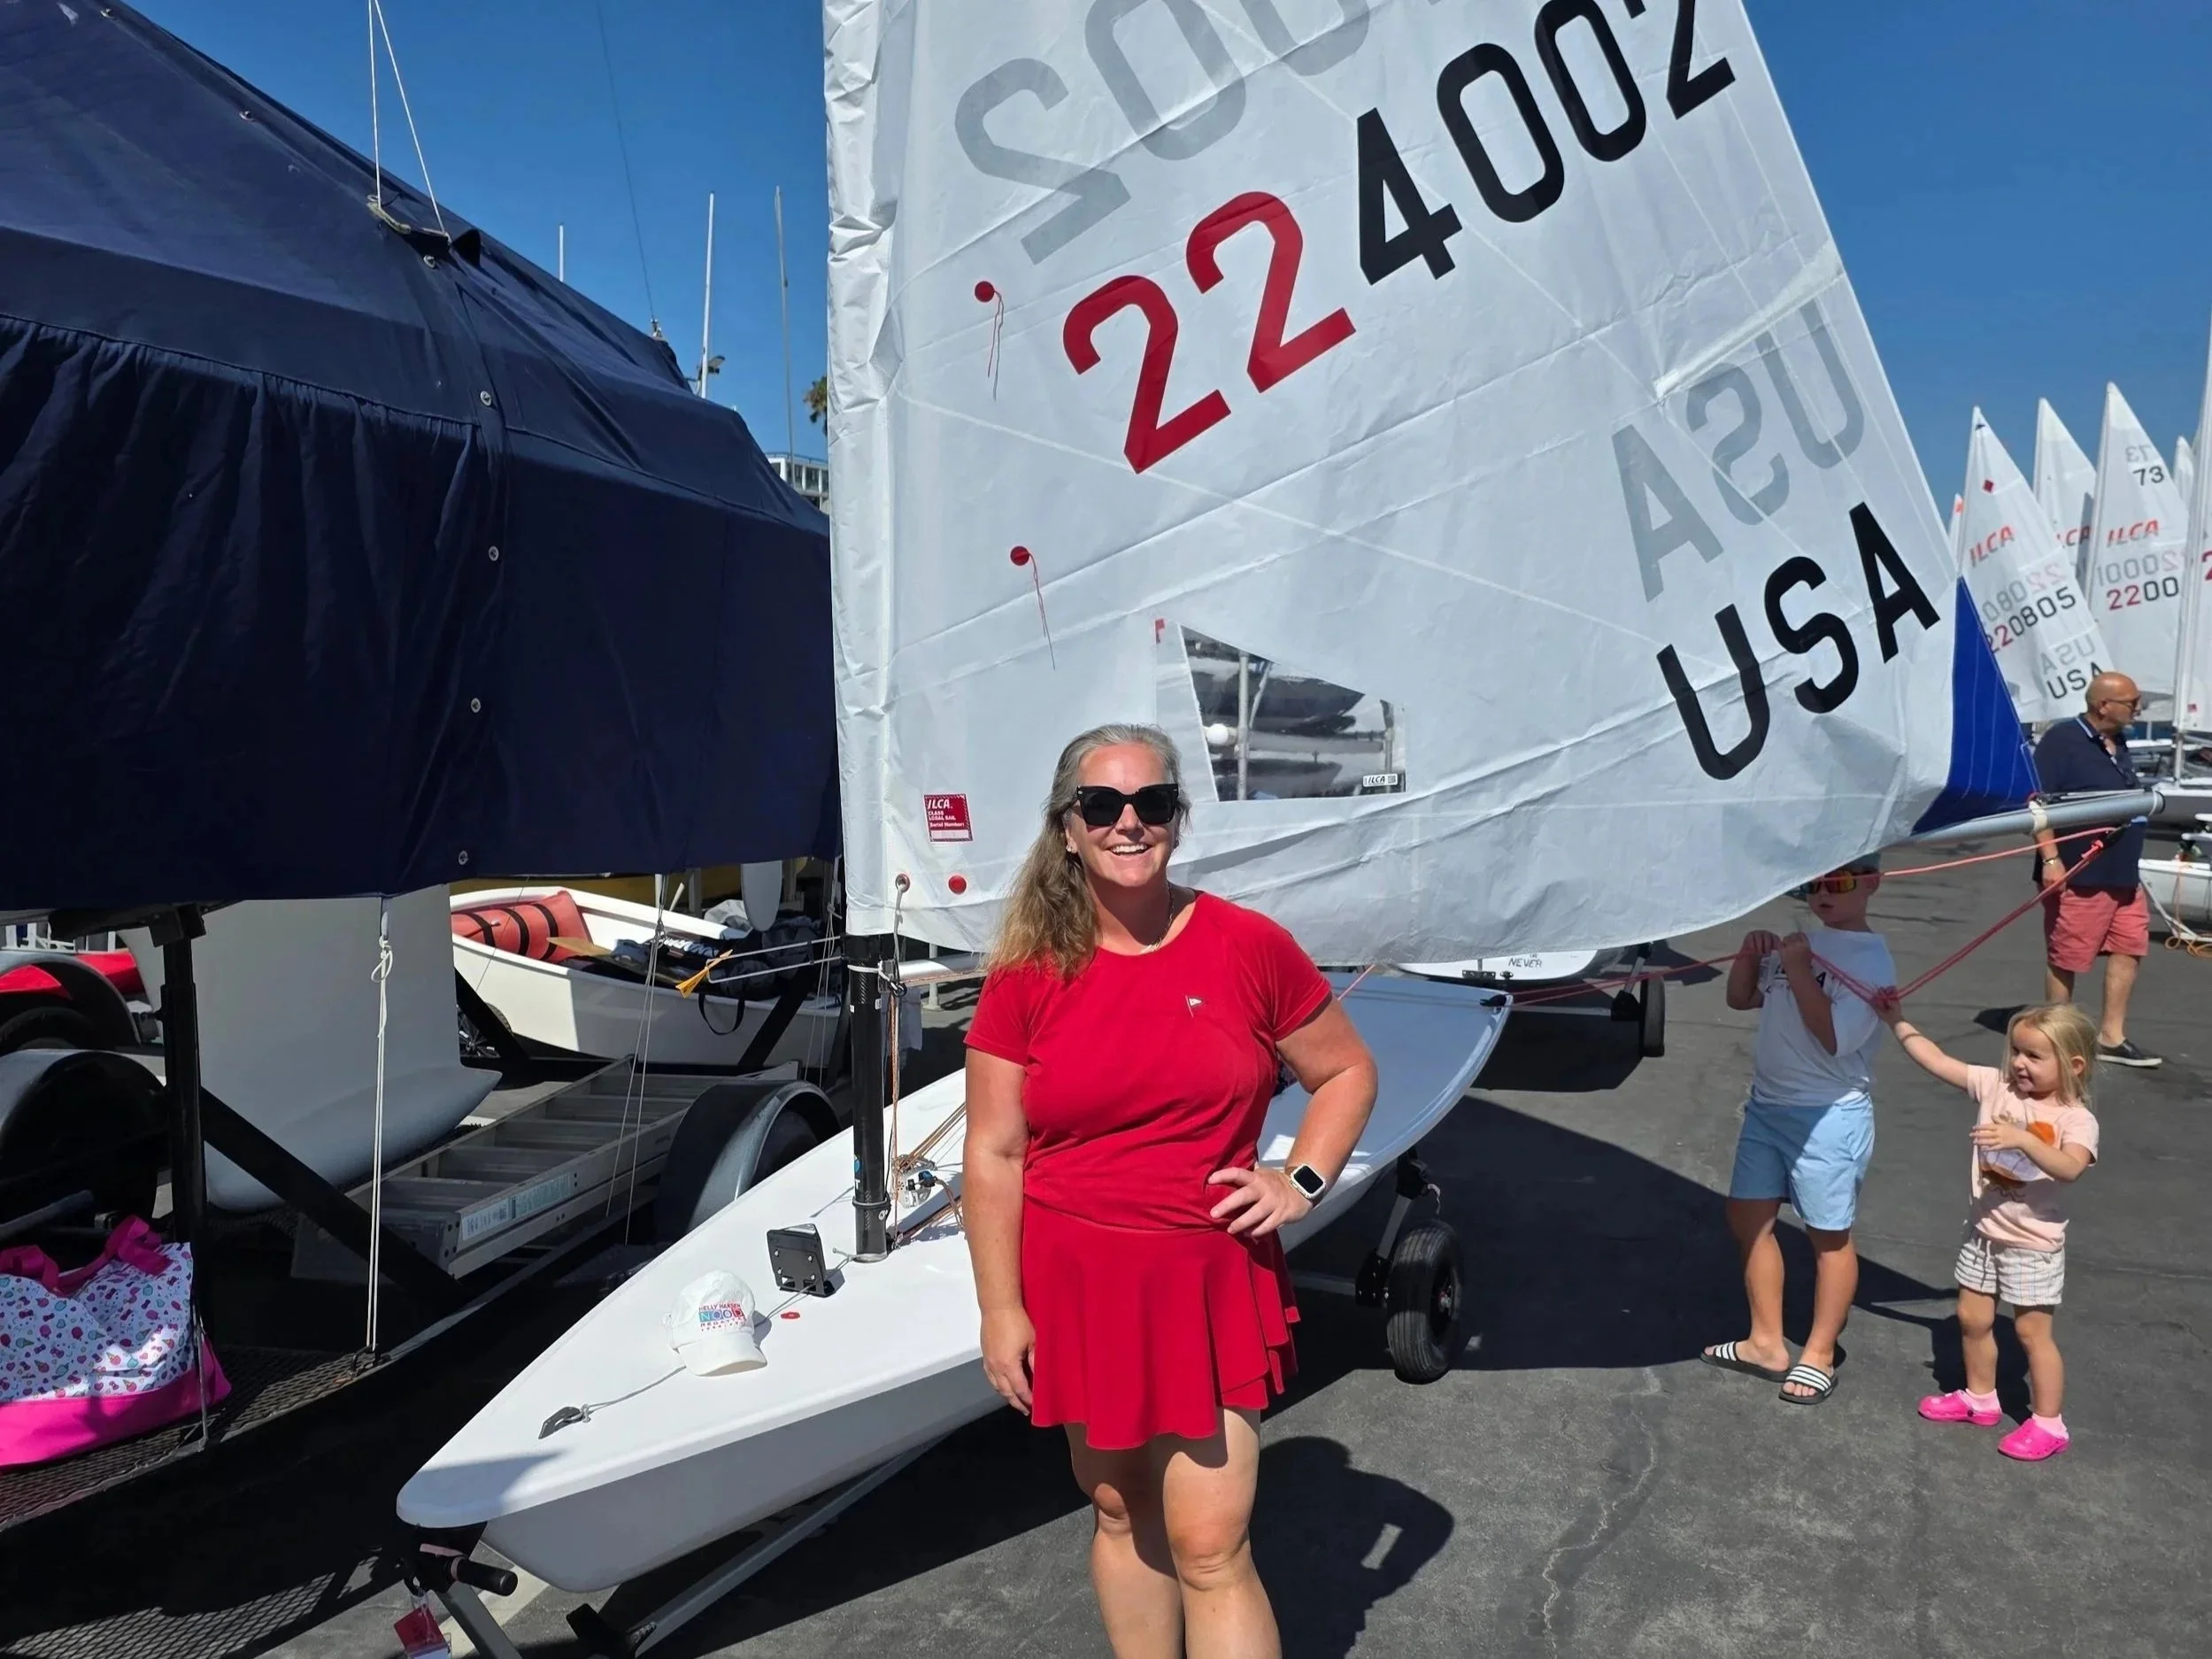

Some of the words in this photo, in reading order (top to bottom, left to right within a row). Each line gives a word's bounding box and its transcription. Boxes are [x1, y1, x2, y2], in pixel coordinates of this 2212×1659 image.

[1062, 0, 1736, 475] 224002
[2133, 466, 2164, 486] 73
[1969, 525, 2015, 567] ILCA
[2107, 520, 2159, 547] ILCA
[1655, 501, 1940, 781] USA
[1508, 958, 1542, 968] NEVER
